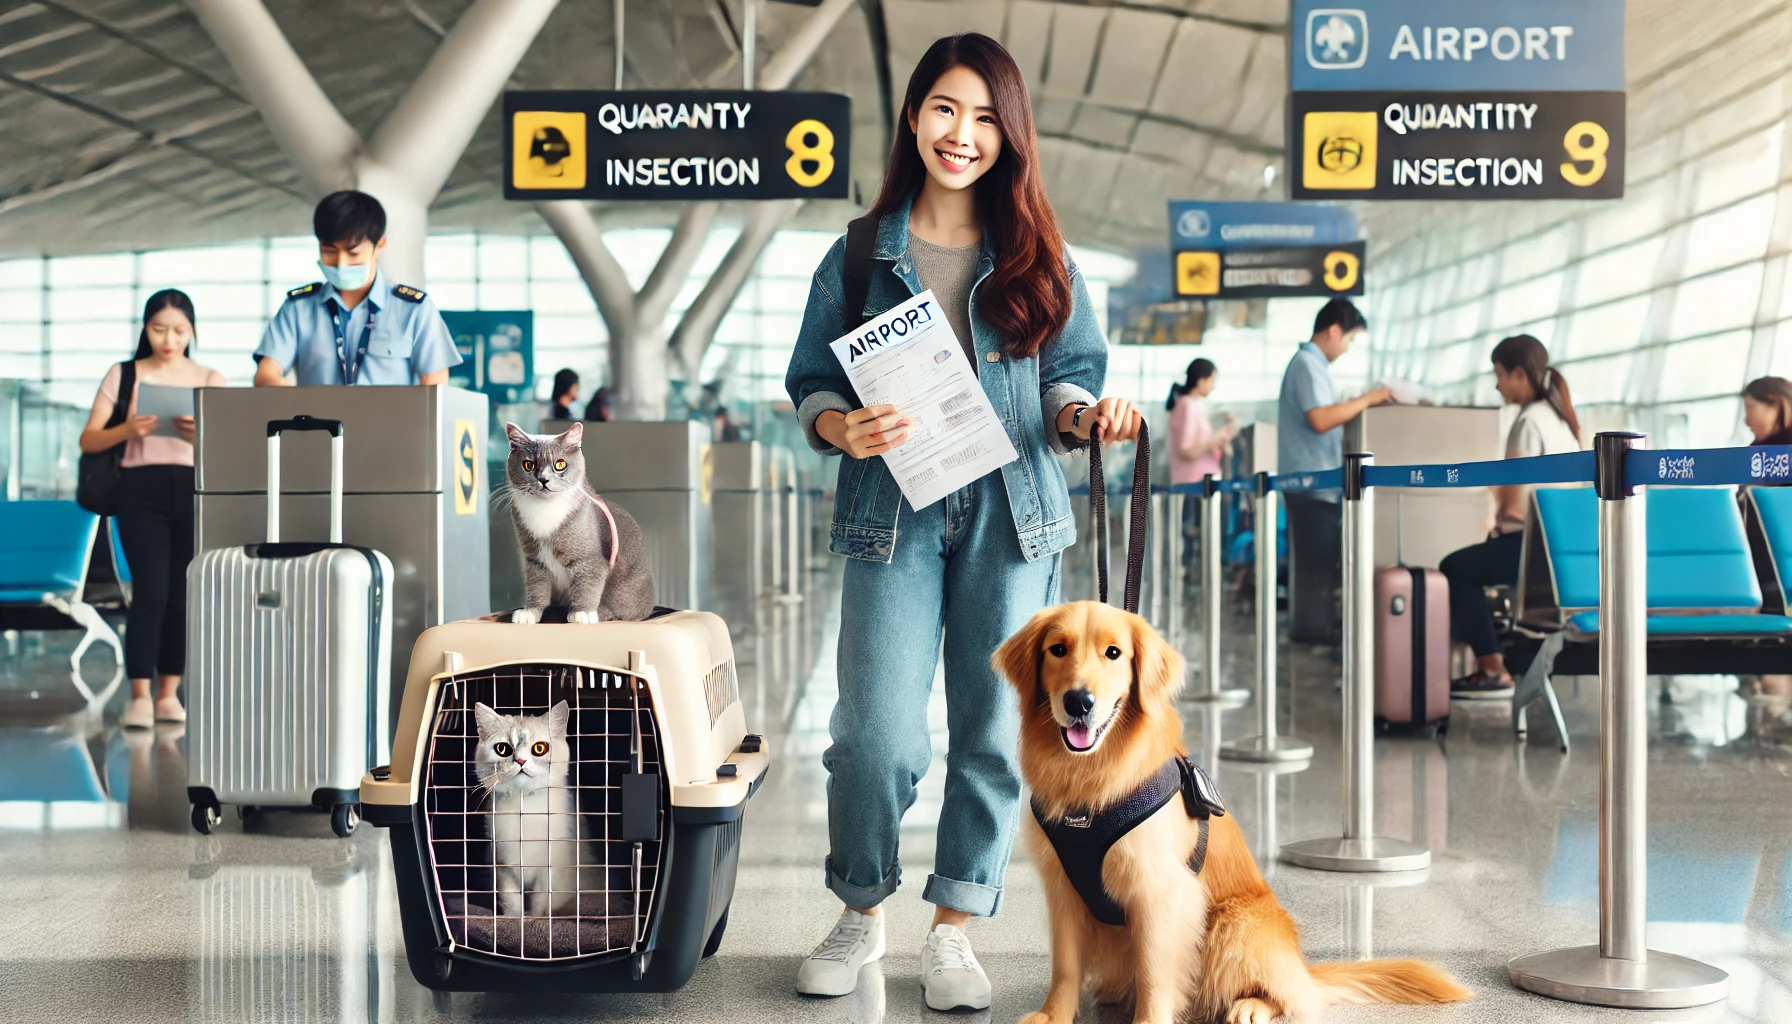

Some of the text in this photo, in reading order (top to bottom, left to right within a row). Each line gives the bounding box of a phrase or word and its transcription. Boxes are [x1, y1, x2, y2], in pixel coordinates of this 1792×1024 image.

[1388, 24, 1574, 62] AIRPORT
[598, 102, 751, 134] QUARANTY
[605, 157, 760, 187] INSECTION
[786, 119, 835, 188] 8
[1392, 157, 1543, 187] INSECTION
[1560, 121, 1609, 187] 9
[849, 301, 932, 363] AIRPORT
